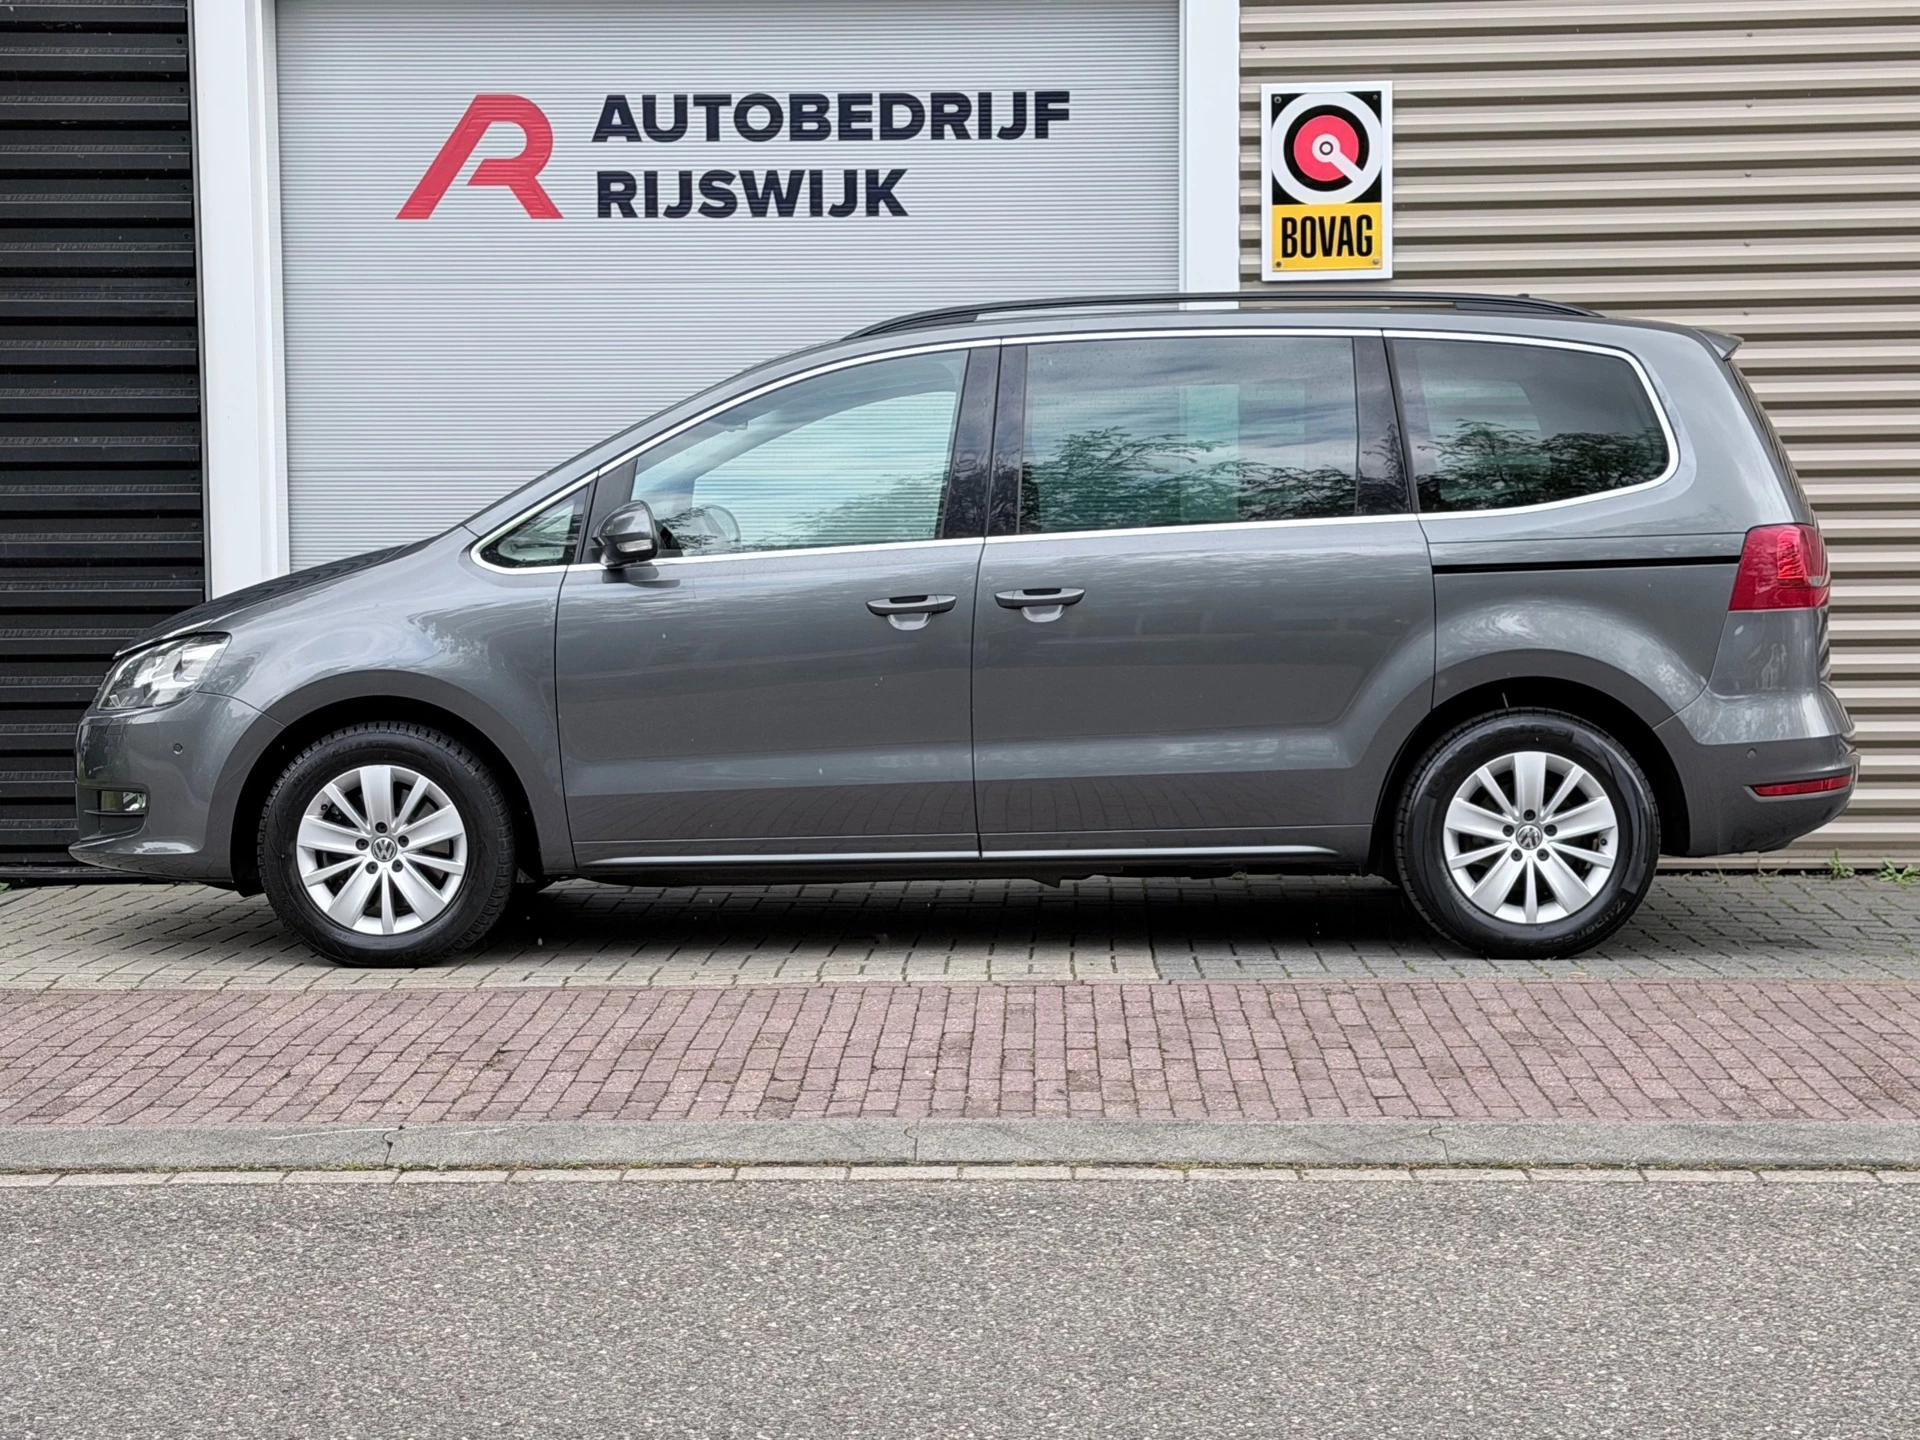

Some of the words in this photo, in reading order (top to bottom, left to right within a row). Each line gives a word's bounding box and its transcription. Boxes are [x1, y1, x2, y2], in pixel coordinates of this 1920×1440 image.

[592, 90, 1069, 142] AUTOBEDRIJF
[597, 168, 907, 219] RIJSWIJK
[1281, 214, 1373, 259] BOVAG
